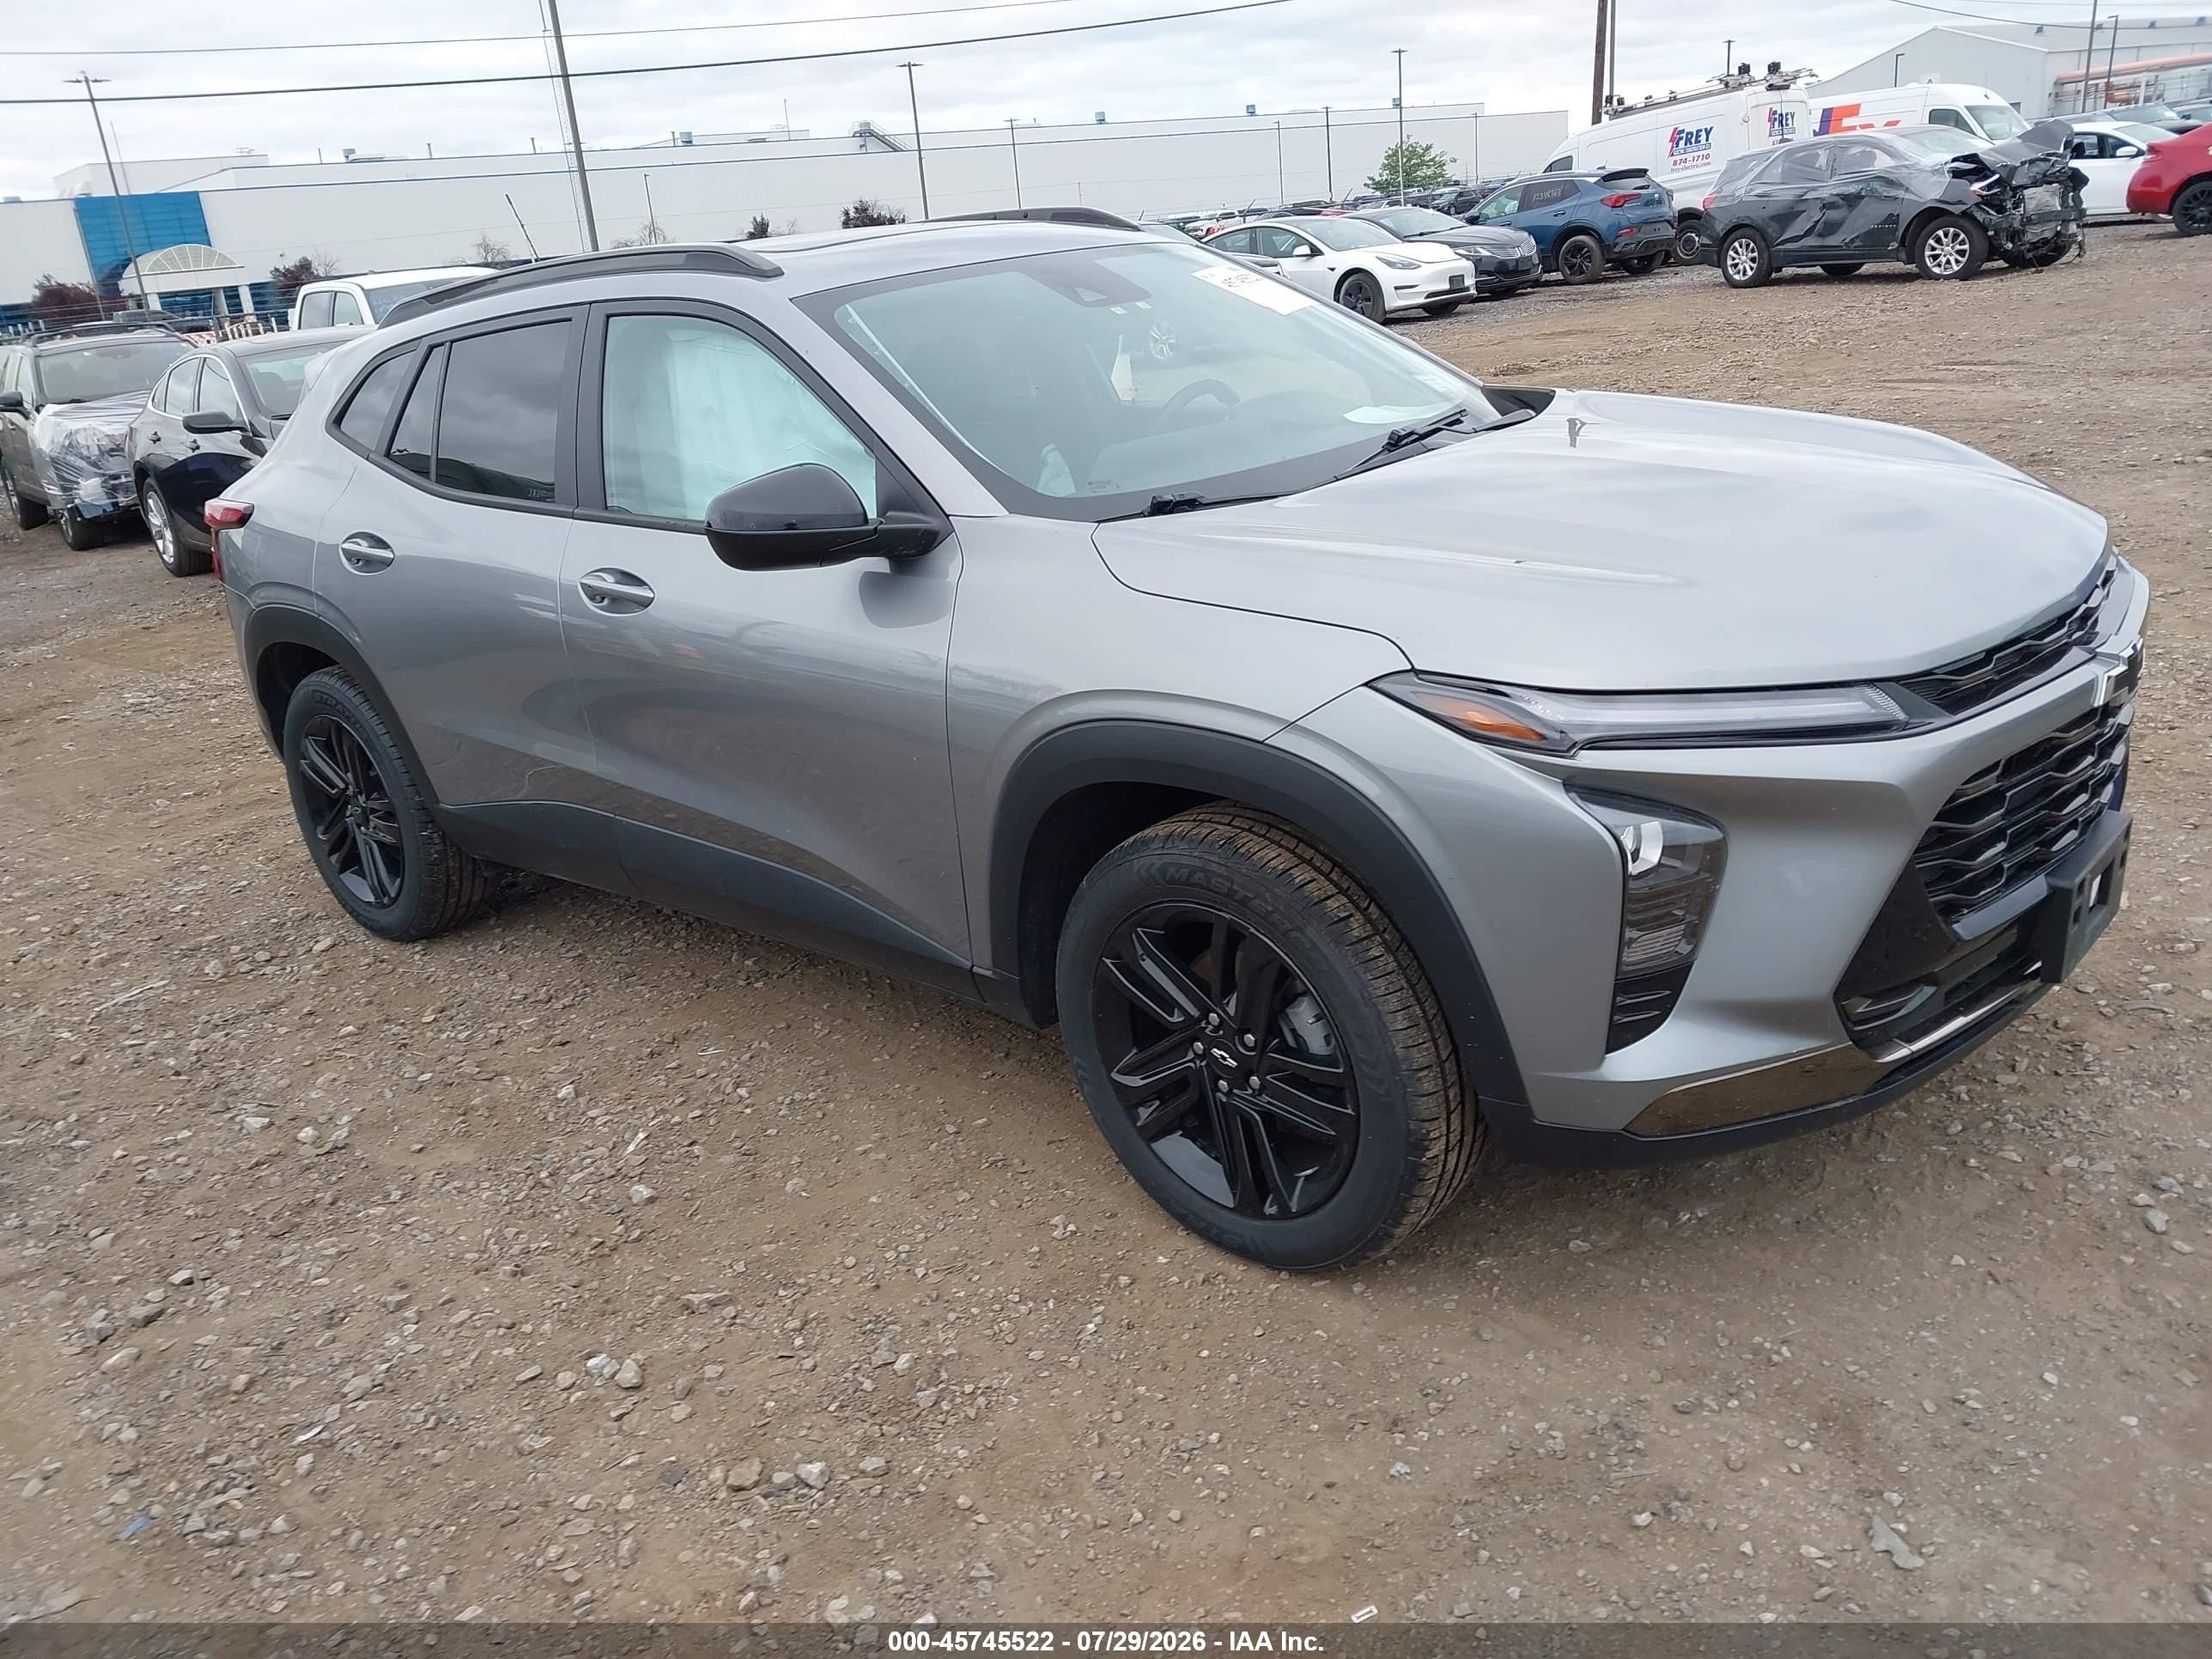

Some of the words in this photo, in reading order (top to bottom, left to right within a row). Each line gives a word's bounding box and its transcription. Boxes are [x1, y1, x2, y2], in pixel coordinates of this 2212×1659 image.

[1771, 110, 1796, 129] FREY
[1675, 126, 1715, 148] FREY
[1673, 153, 1711, 167] 874-1710
